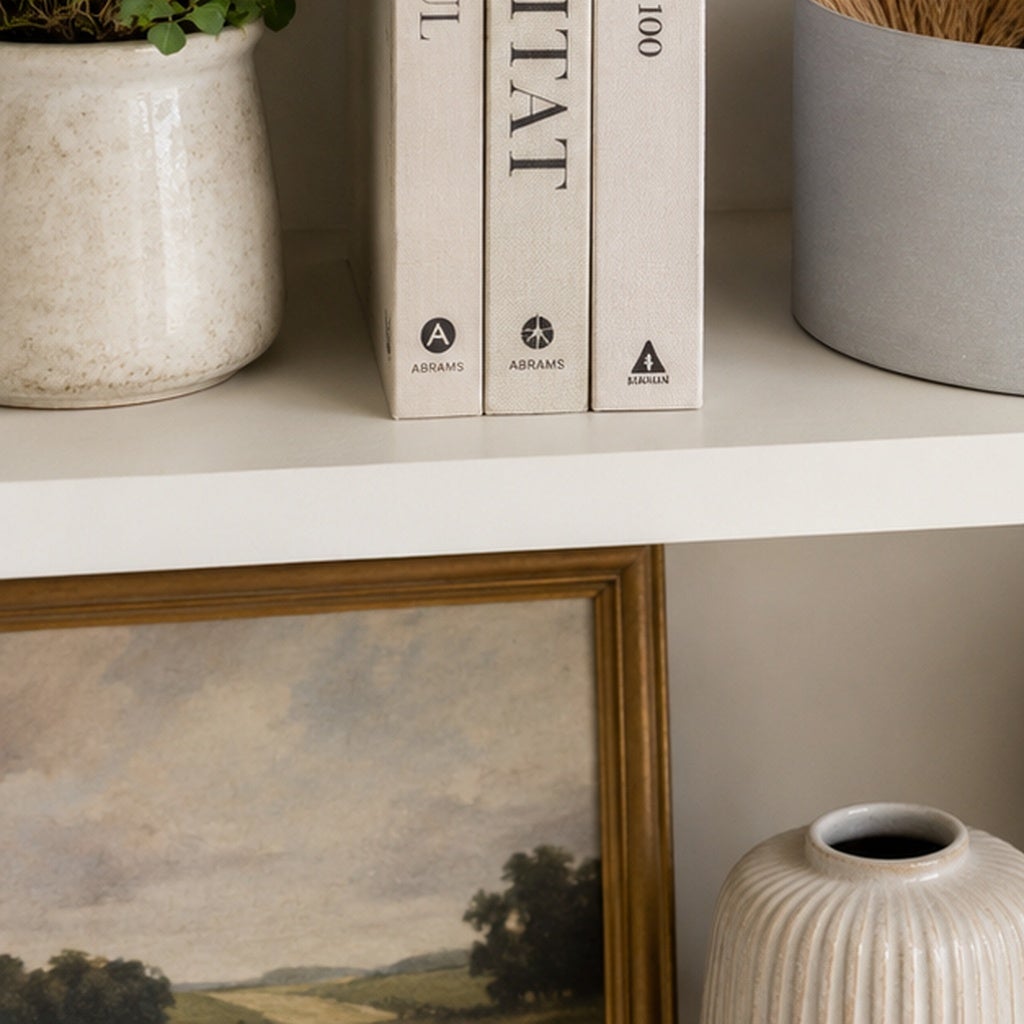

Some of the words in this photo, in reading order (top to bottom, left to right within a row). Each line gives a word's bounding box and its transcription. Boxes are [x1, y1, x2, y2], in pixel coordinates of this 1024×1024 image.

[637, 5, 662, 58] 100
[411, 361, 465, 374] ABRAMS
[508, 358, 565, 371] ABRAMS
